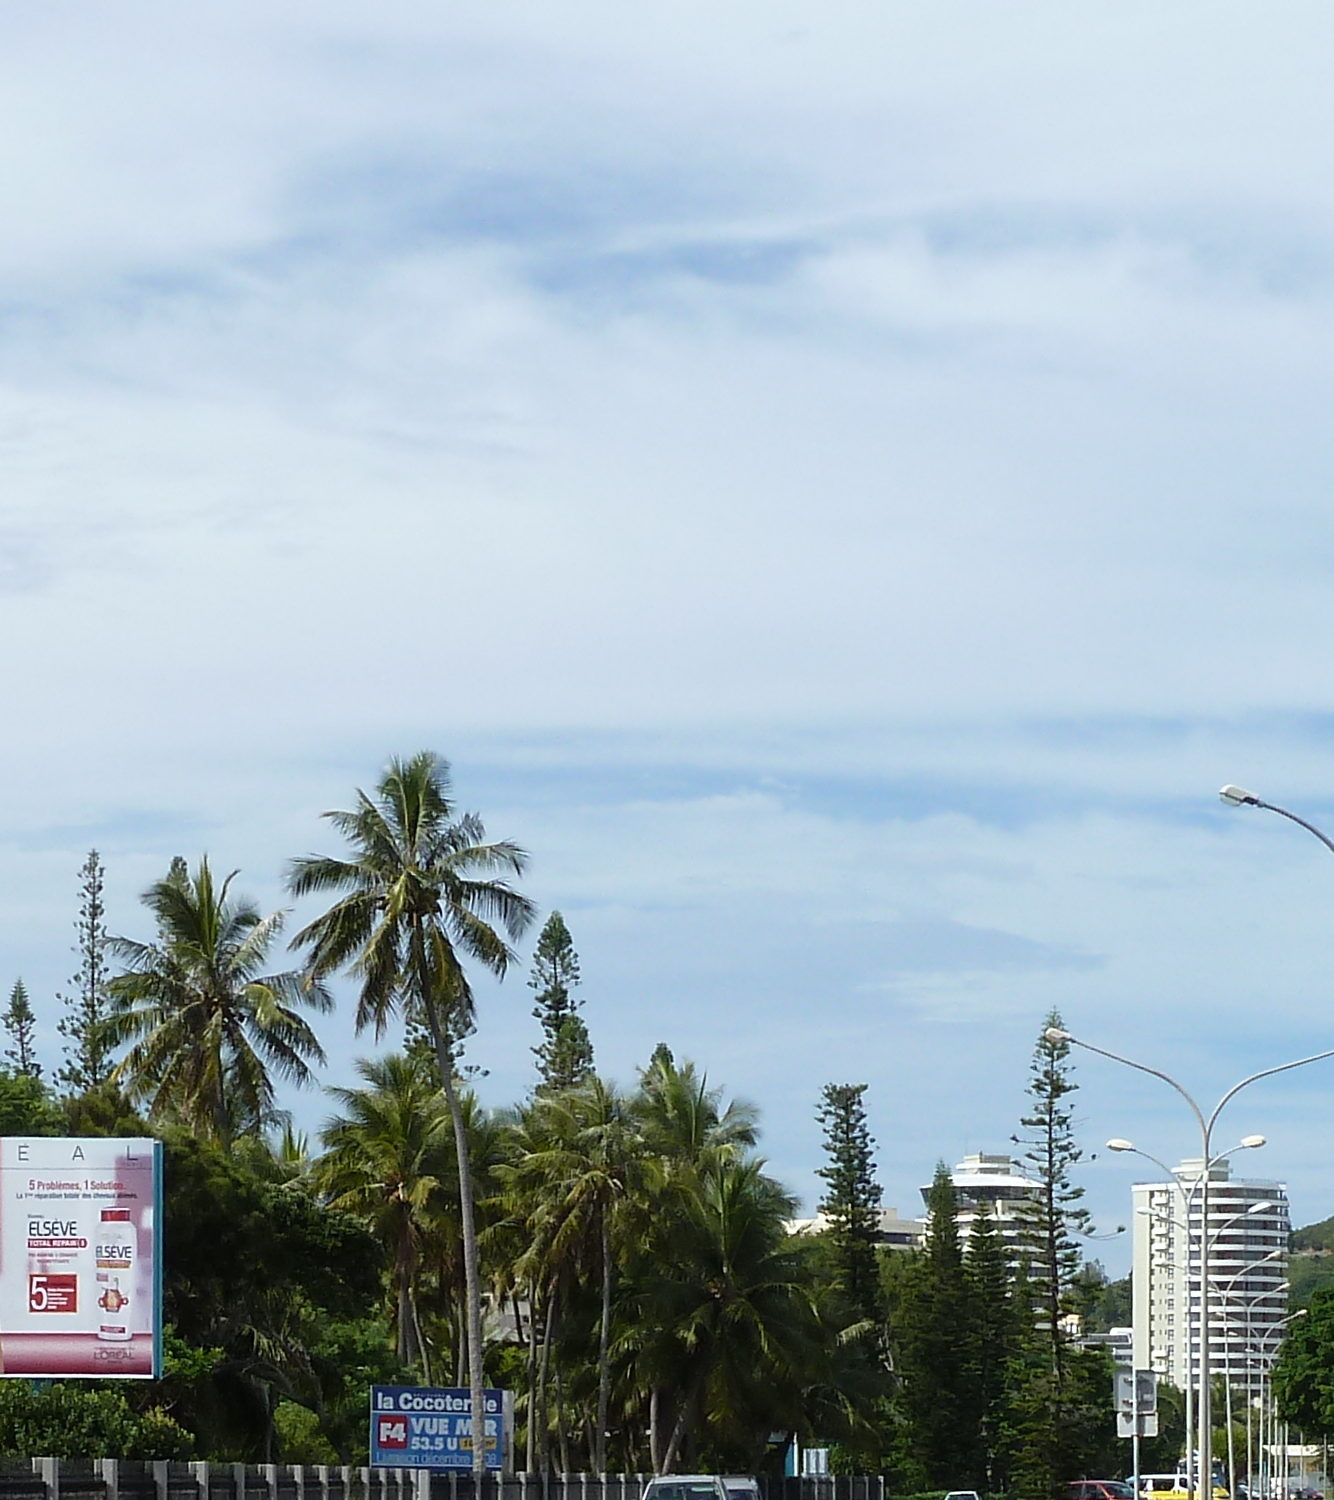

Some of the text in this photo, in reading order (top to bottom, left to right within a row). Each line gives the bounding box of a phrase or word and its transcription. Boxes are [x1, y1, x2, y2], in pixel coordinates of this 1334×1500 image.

[29, 1179, 36, 1190] 5
[29, 1218, 77, 1237] ELSÈVE
[30, 1276, 49, 1310] 5
[377, 1392, 497, 1412] la Cocoterie
[379, 1422, 406, 1442] F4
[411, 1417, 497, 1436] VUE MR
[411, 1437, 443, 1450] 53.5
[447, 1437, 458, 1450] U
